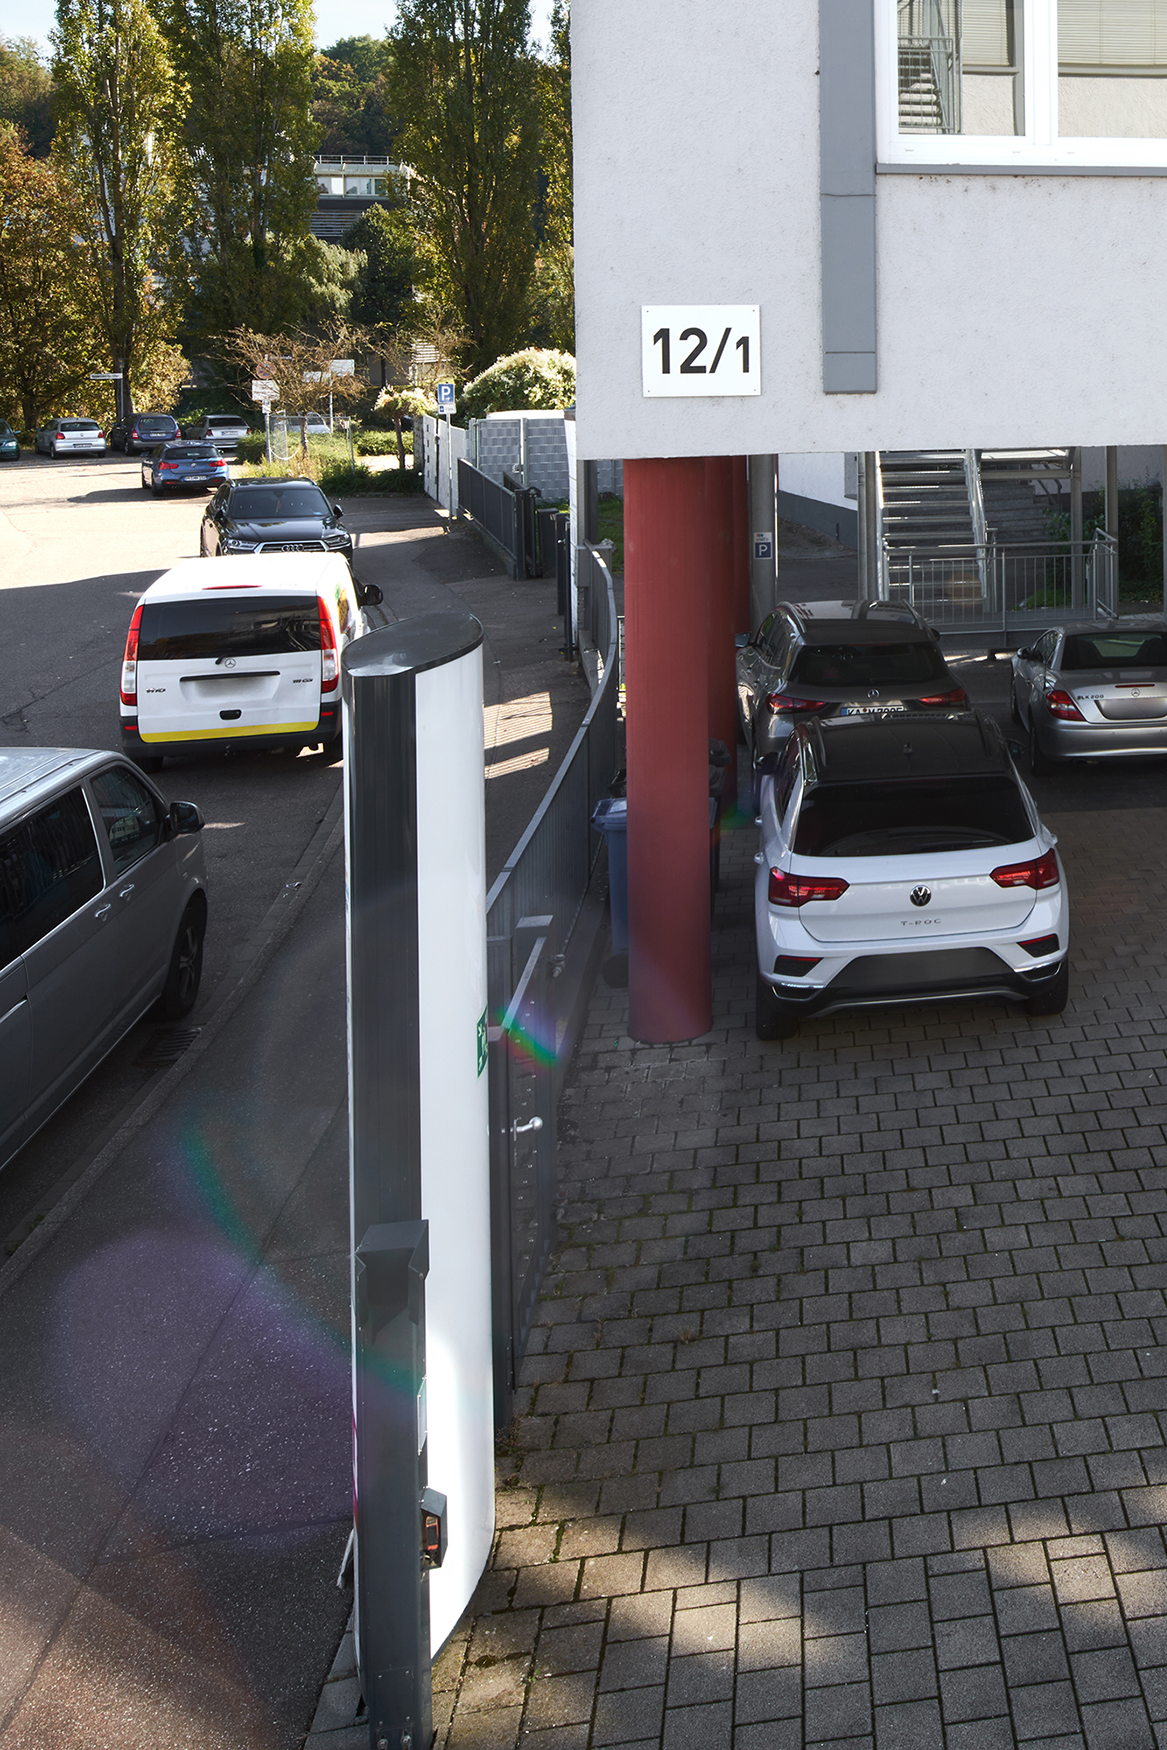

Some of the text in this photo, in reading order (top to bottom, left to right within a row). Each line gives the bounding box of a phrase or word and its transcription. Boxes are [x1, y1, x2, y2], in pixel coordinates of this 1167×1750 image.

[652, 327, 750, 374] 12/1
[441, 385, 451, 401] P
[758, 543, 768, 556] P
[901, 918, 942, 926] T-ROC
